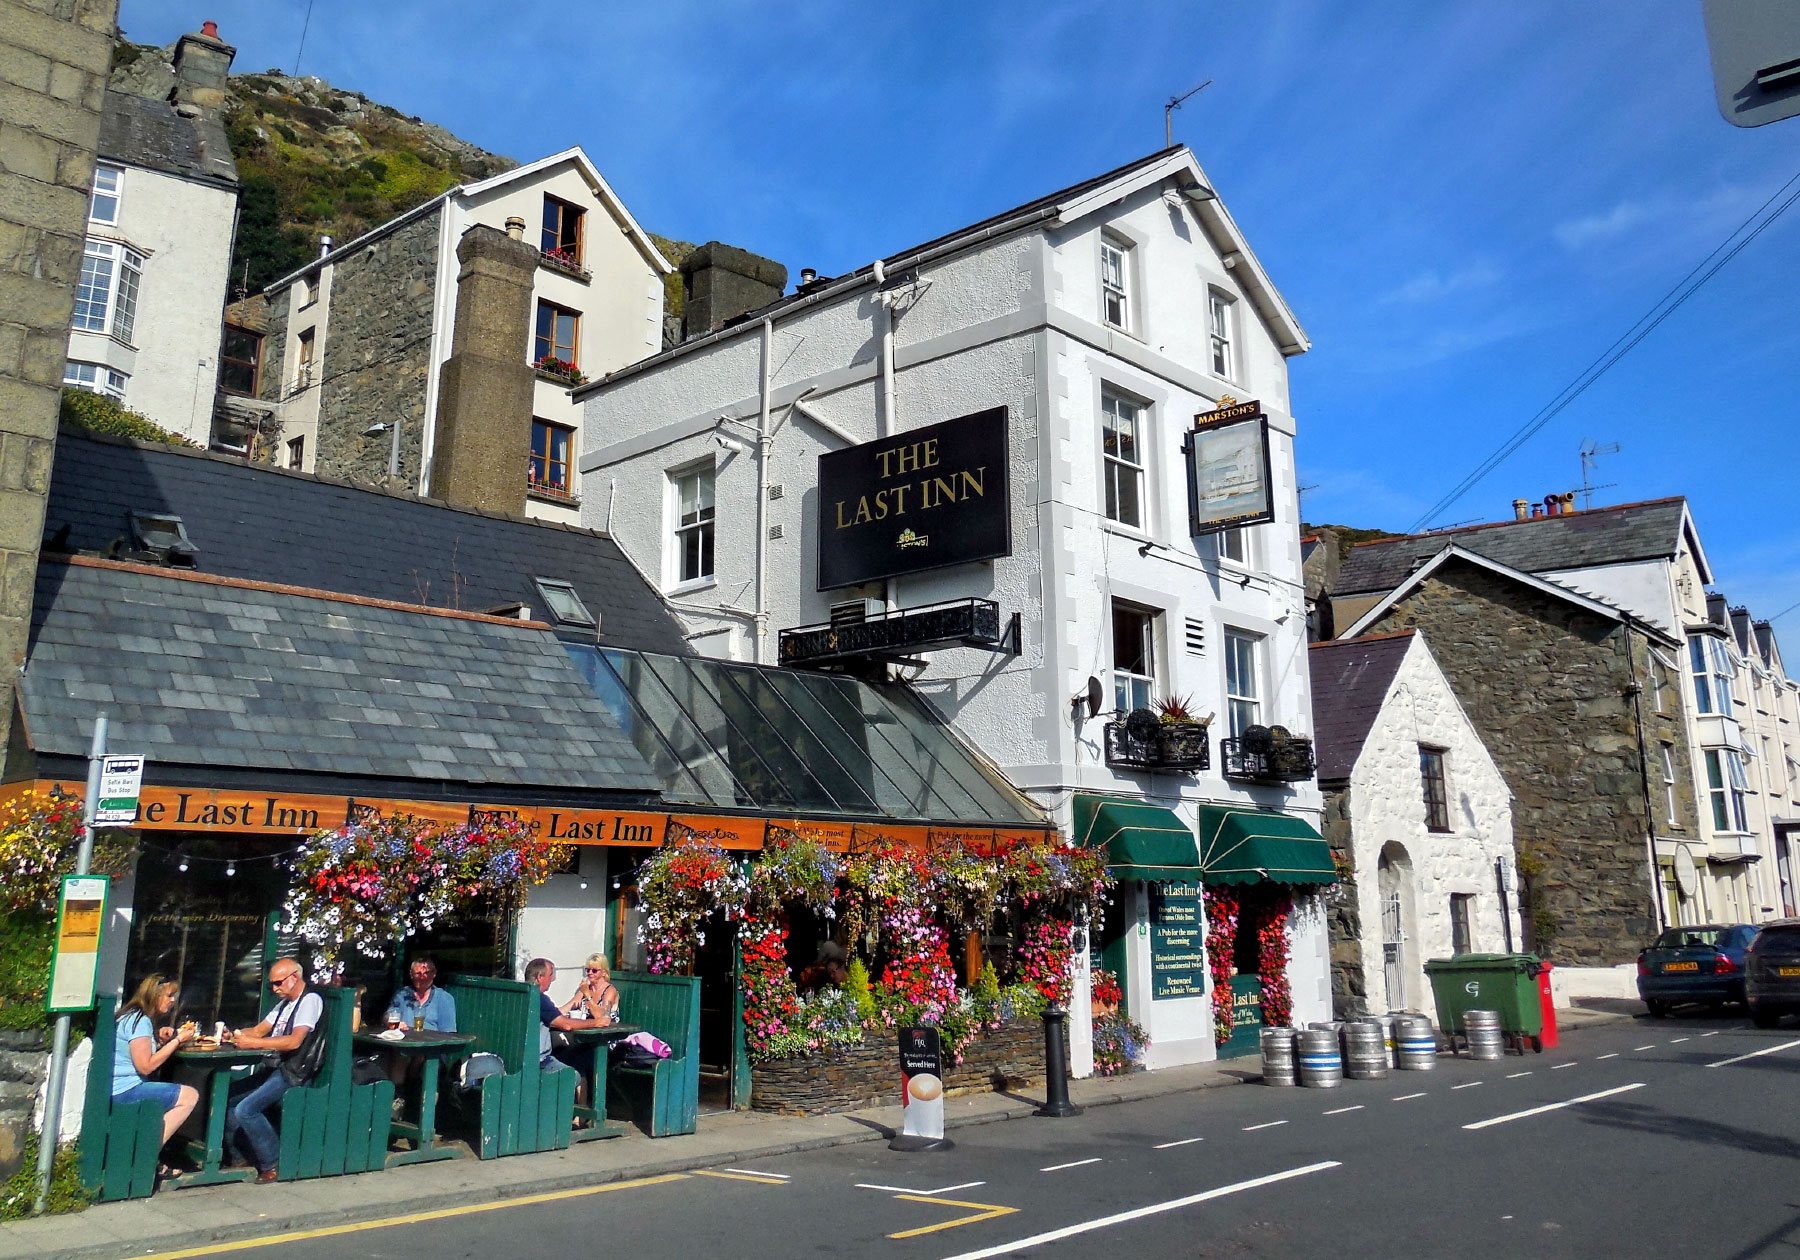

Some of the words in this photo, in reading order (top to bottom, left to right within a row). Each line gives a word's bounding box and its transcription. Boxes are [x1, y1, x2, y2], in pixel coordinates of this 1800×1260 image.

[1198, 404, 1255, 425] MARSTON'S
[876, 438, 940, 479] THE
[835, 484, 911, 530] LAST
[920, 466, 987, 510] INN
[174, 793, 254, 826] Last
[263, 797, 319, 829] Inn
[547, 813, 606, 842] Last
[611, 816, 653, 842] Inn
[963, 832, 973, 840] the
[1154, 883, 1169, 896] The
[1169, 884, 1184, 896] Last
[1184, 884, 1196, 896] Inn
[1157, 929, 1162, 937] A
[1162, 928, 1171, 936] Pub
[1167, 976, 1192, 985] Renowned
[1159, 987, 1170, 995] Live
[1171, 986, 1185, 994] Music
[1186, 985, 1201, 993] Venue
[1232, 992, 1248, 1006] Last
[906, 1060, 924, 1068] Served
[924, 1061, 936, 1069] Here
